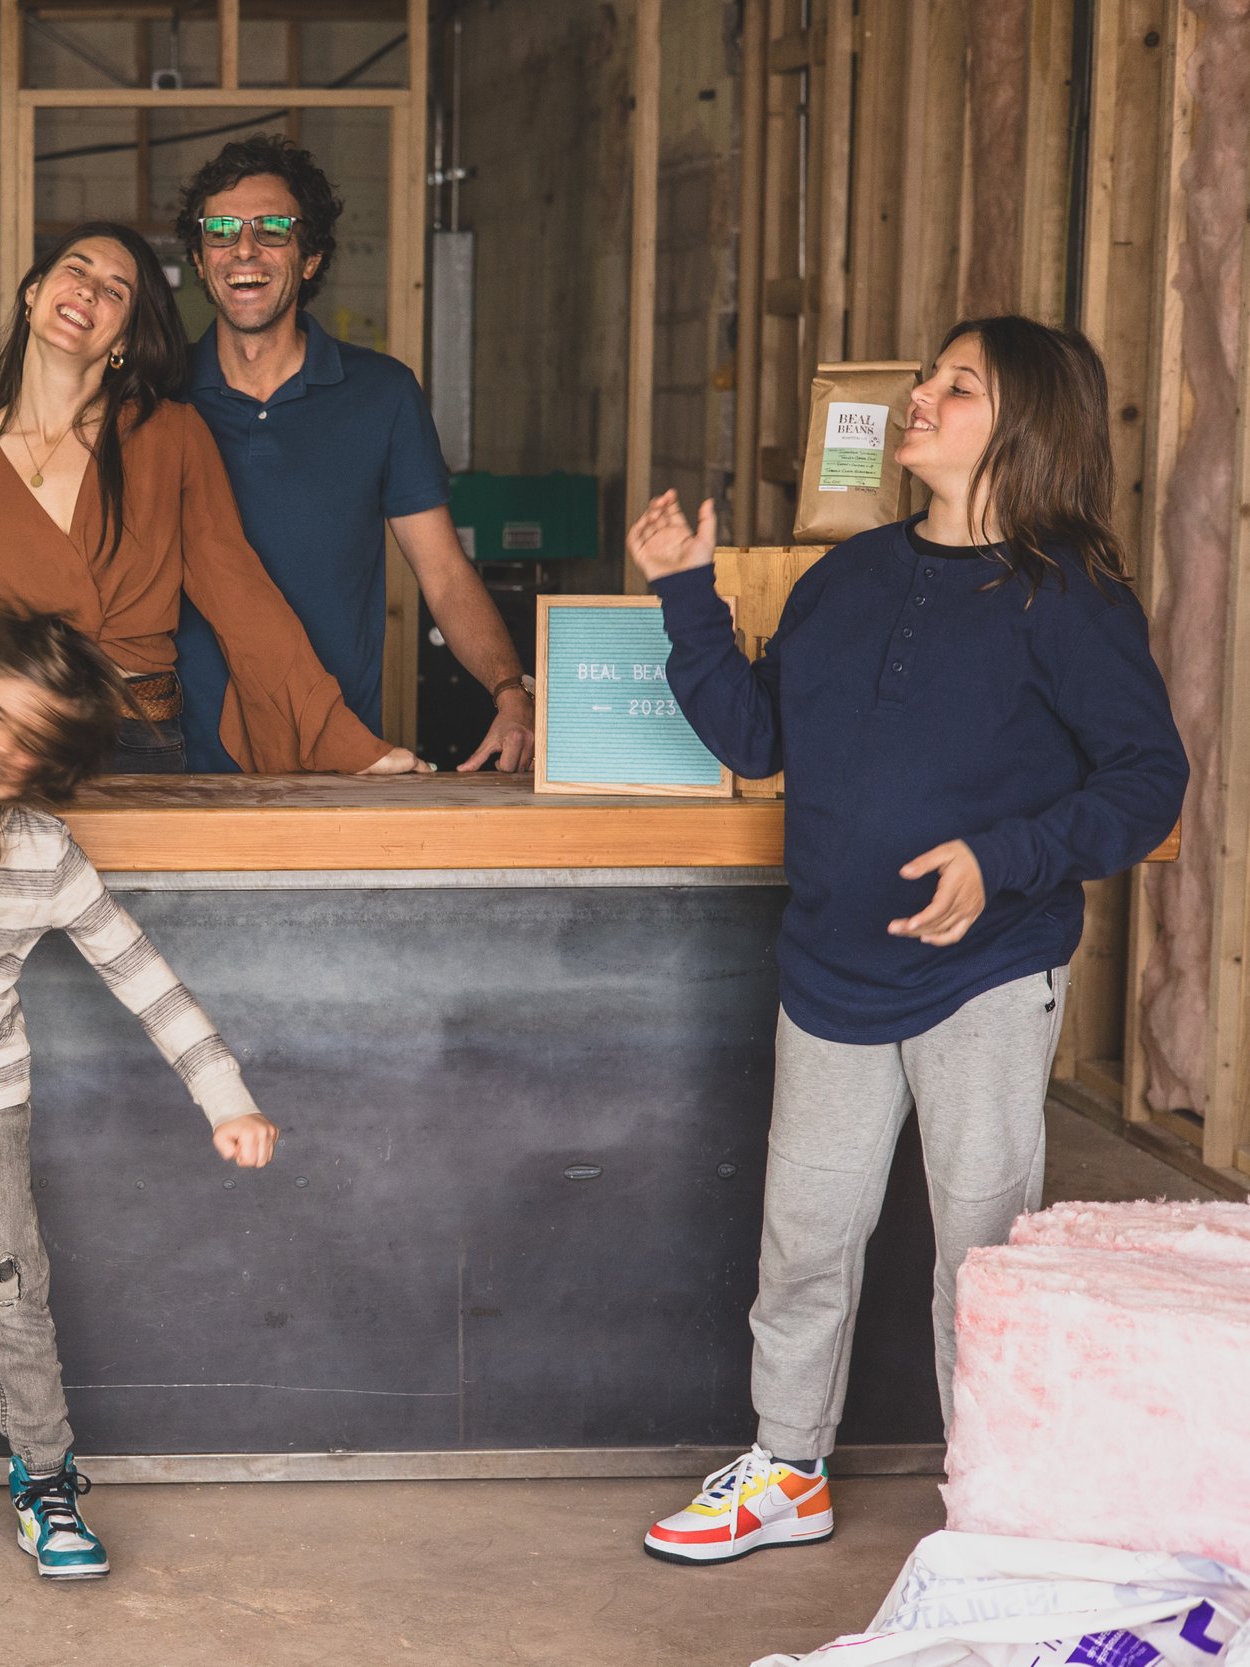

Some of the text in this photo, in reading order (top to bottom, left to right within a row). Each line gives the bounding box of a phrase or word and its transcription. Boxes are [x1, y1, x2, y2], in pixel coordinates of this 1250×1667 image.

[839, 413, 875, 426] BEAL
[837, 424, 874, 435] BEANS
[577, 663, 667, 680] BEAL BEA
[629, 699, 677, 715] 2023
